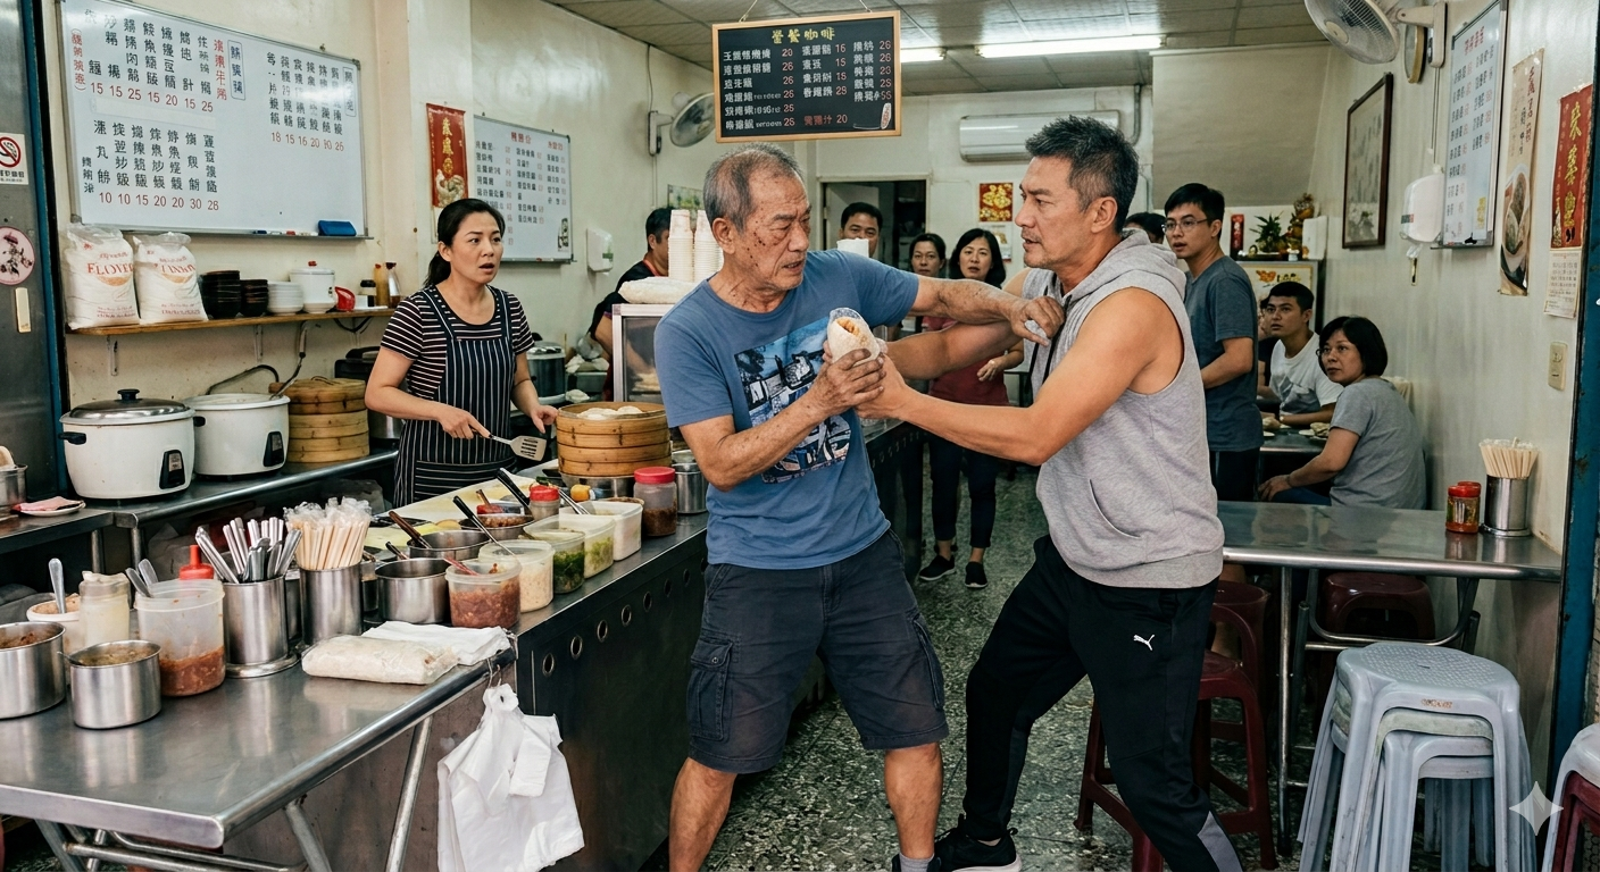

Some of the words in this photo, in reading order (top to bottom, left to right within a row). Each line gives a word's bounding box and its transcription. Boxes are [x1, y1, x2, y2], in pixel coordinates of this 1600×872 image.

[91, 82, 104, 95] 15
[109, 85, 123, 98] 15
[127, 87, 142, 101] 25
[147, 91, 160, 103] 15
[165, 94, 178, 106] 20
[184, 98, 196, 109] 15
[201, 100, 213, 112] 25
[836, 114, 848, 124] 20
[271, 131, 282, 143] 18
[285, 134, 296, 144] 15
[99, 192, 112, 204] 10
[118, 193, 131, 205] 10
[136, 194, 149, 206] 15
[154, 195, 167, 207] 20
[172, 197, 184, 208] 20
[190, 198, 202, 209] 30
